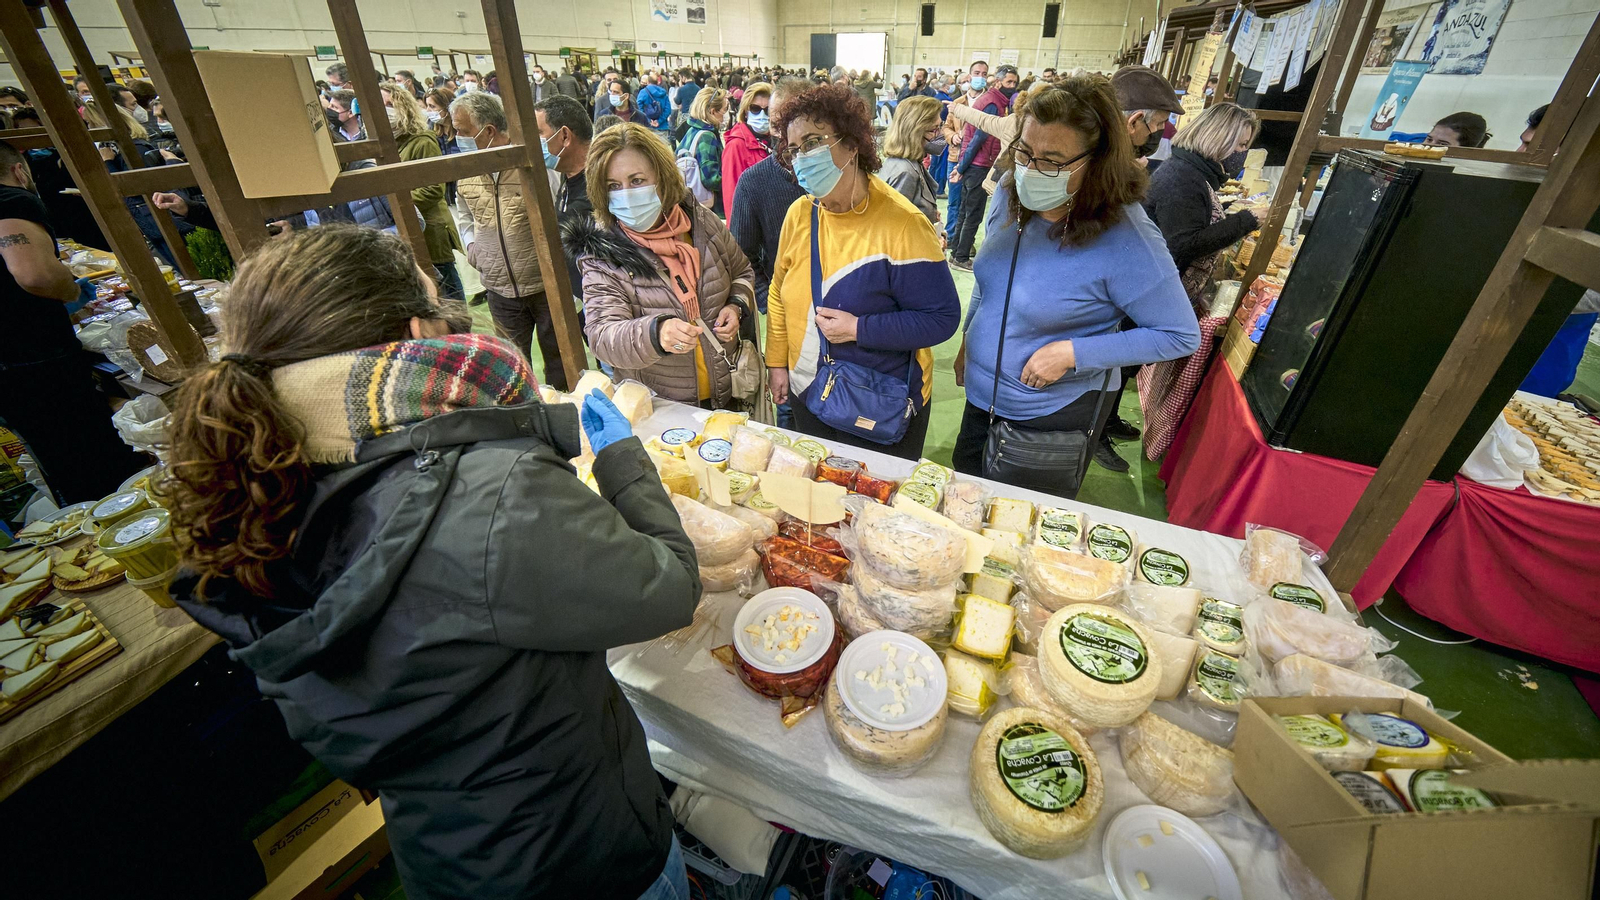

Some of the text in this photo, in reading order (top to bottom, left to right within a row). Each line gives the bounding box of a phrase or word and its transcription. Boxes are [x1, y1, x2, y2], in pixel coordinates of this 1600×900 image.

[1442, 12, 1488, 39] ANDAZUL
[1071, 627, 1106, 645] Covacha
[1107, 641, 1119, 651] La
[1203, 663, 1235, 681] La Covacha
[1006, 753, 1055, 768] La Covacha
[1420, 796, 1481, 808] La Covacha
[268, 789, 352, 857] La Covacha
